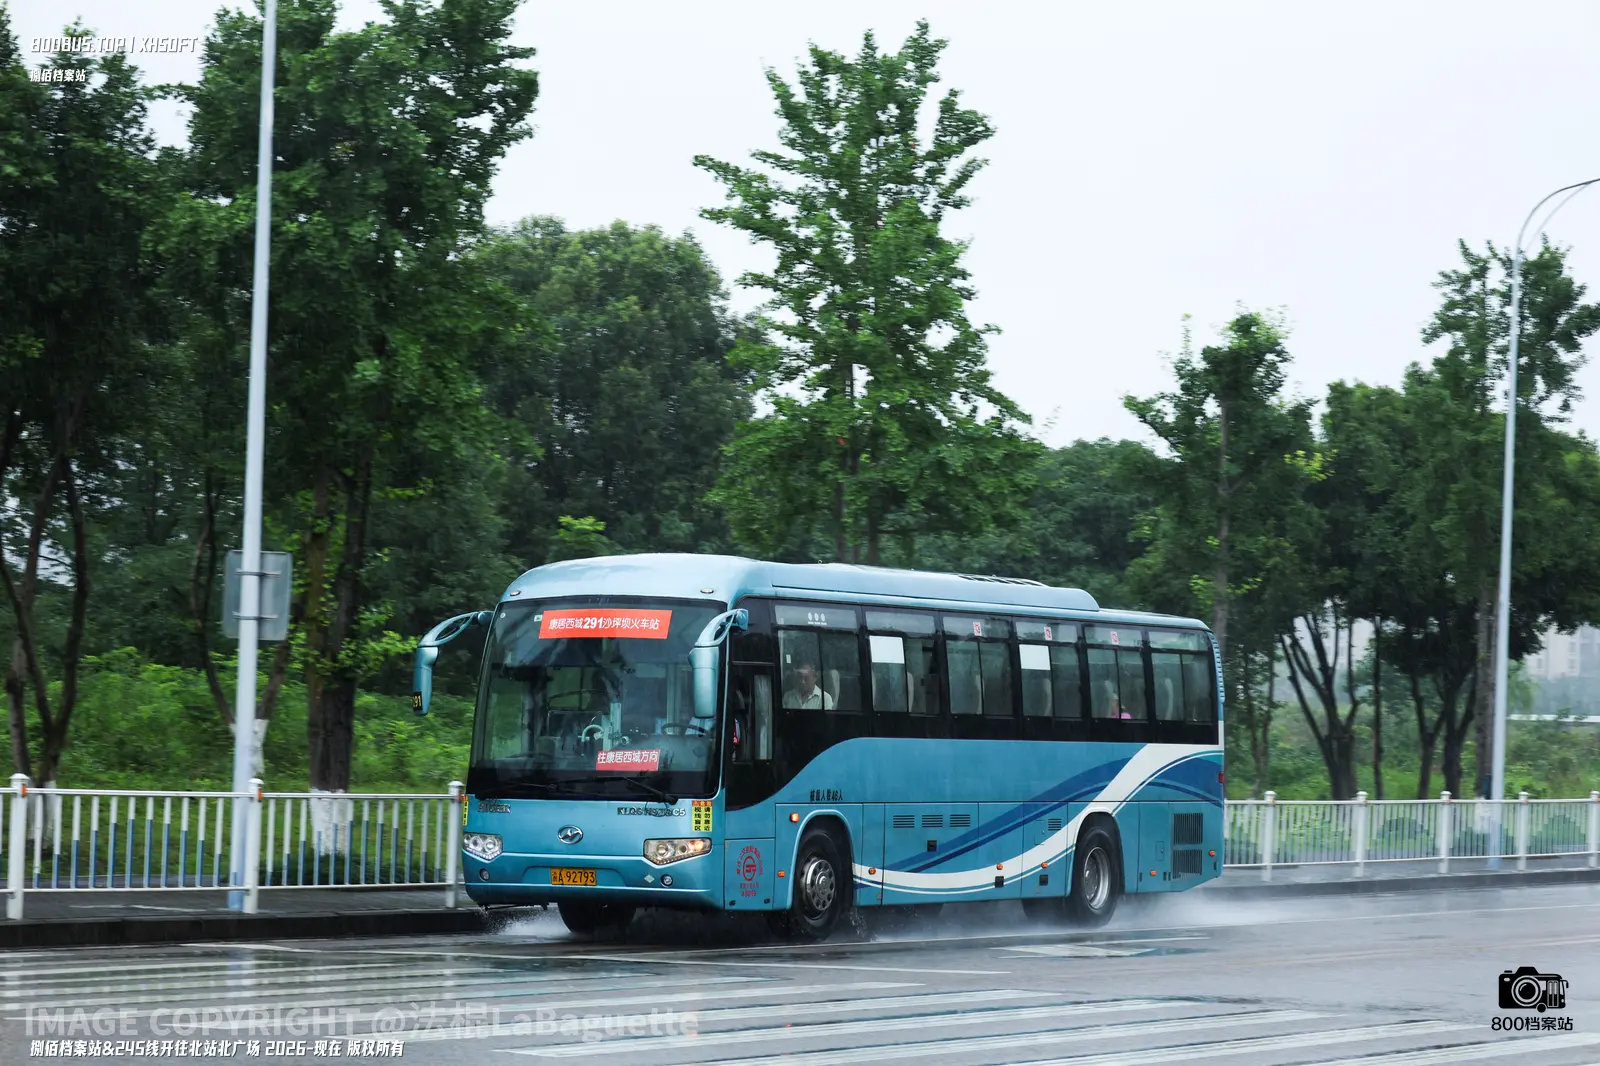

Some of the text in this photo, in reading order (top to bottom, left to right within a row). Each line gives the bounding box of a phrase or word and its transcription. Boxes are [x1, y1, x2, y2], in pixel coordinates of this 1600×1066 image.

[548, 617, 660, 630] 康居西城291沙坪坝火车站
[597, 750, 658, 764] 往康居西城方向
